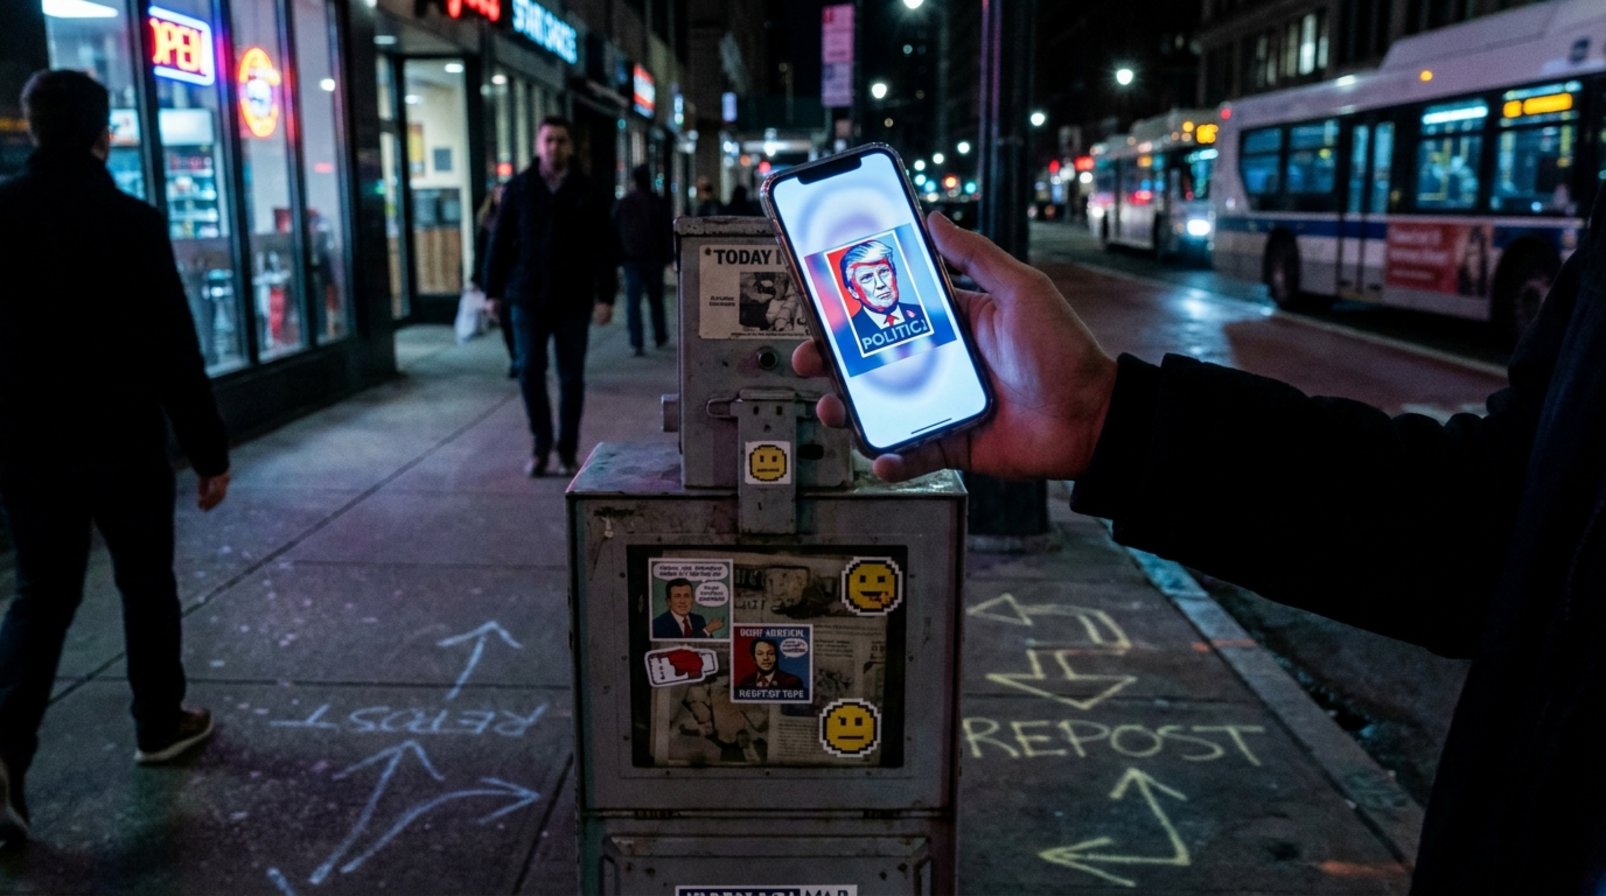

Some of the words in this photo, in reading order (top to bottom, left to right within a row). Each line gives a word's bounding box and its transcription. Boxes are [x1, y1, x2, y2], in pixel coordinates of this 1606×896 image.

[713, 249, 772, 265] TODAY
[269, 702, 548, 737] REPOST
[962, 716, 1265, 767] REPOST
